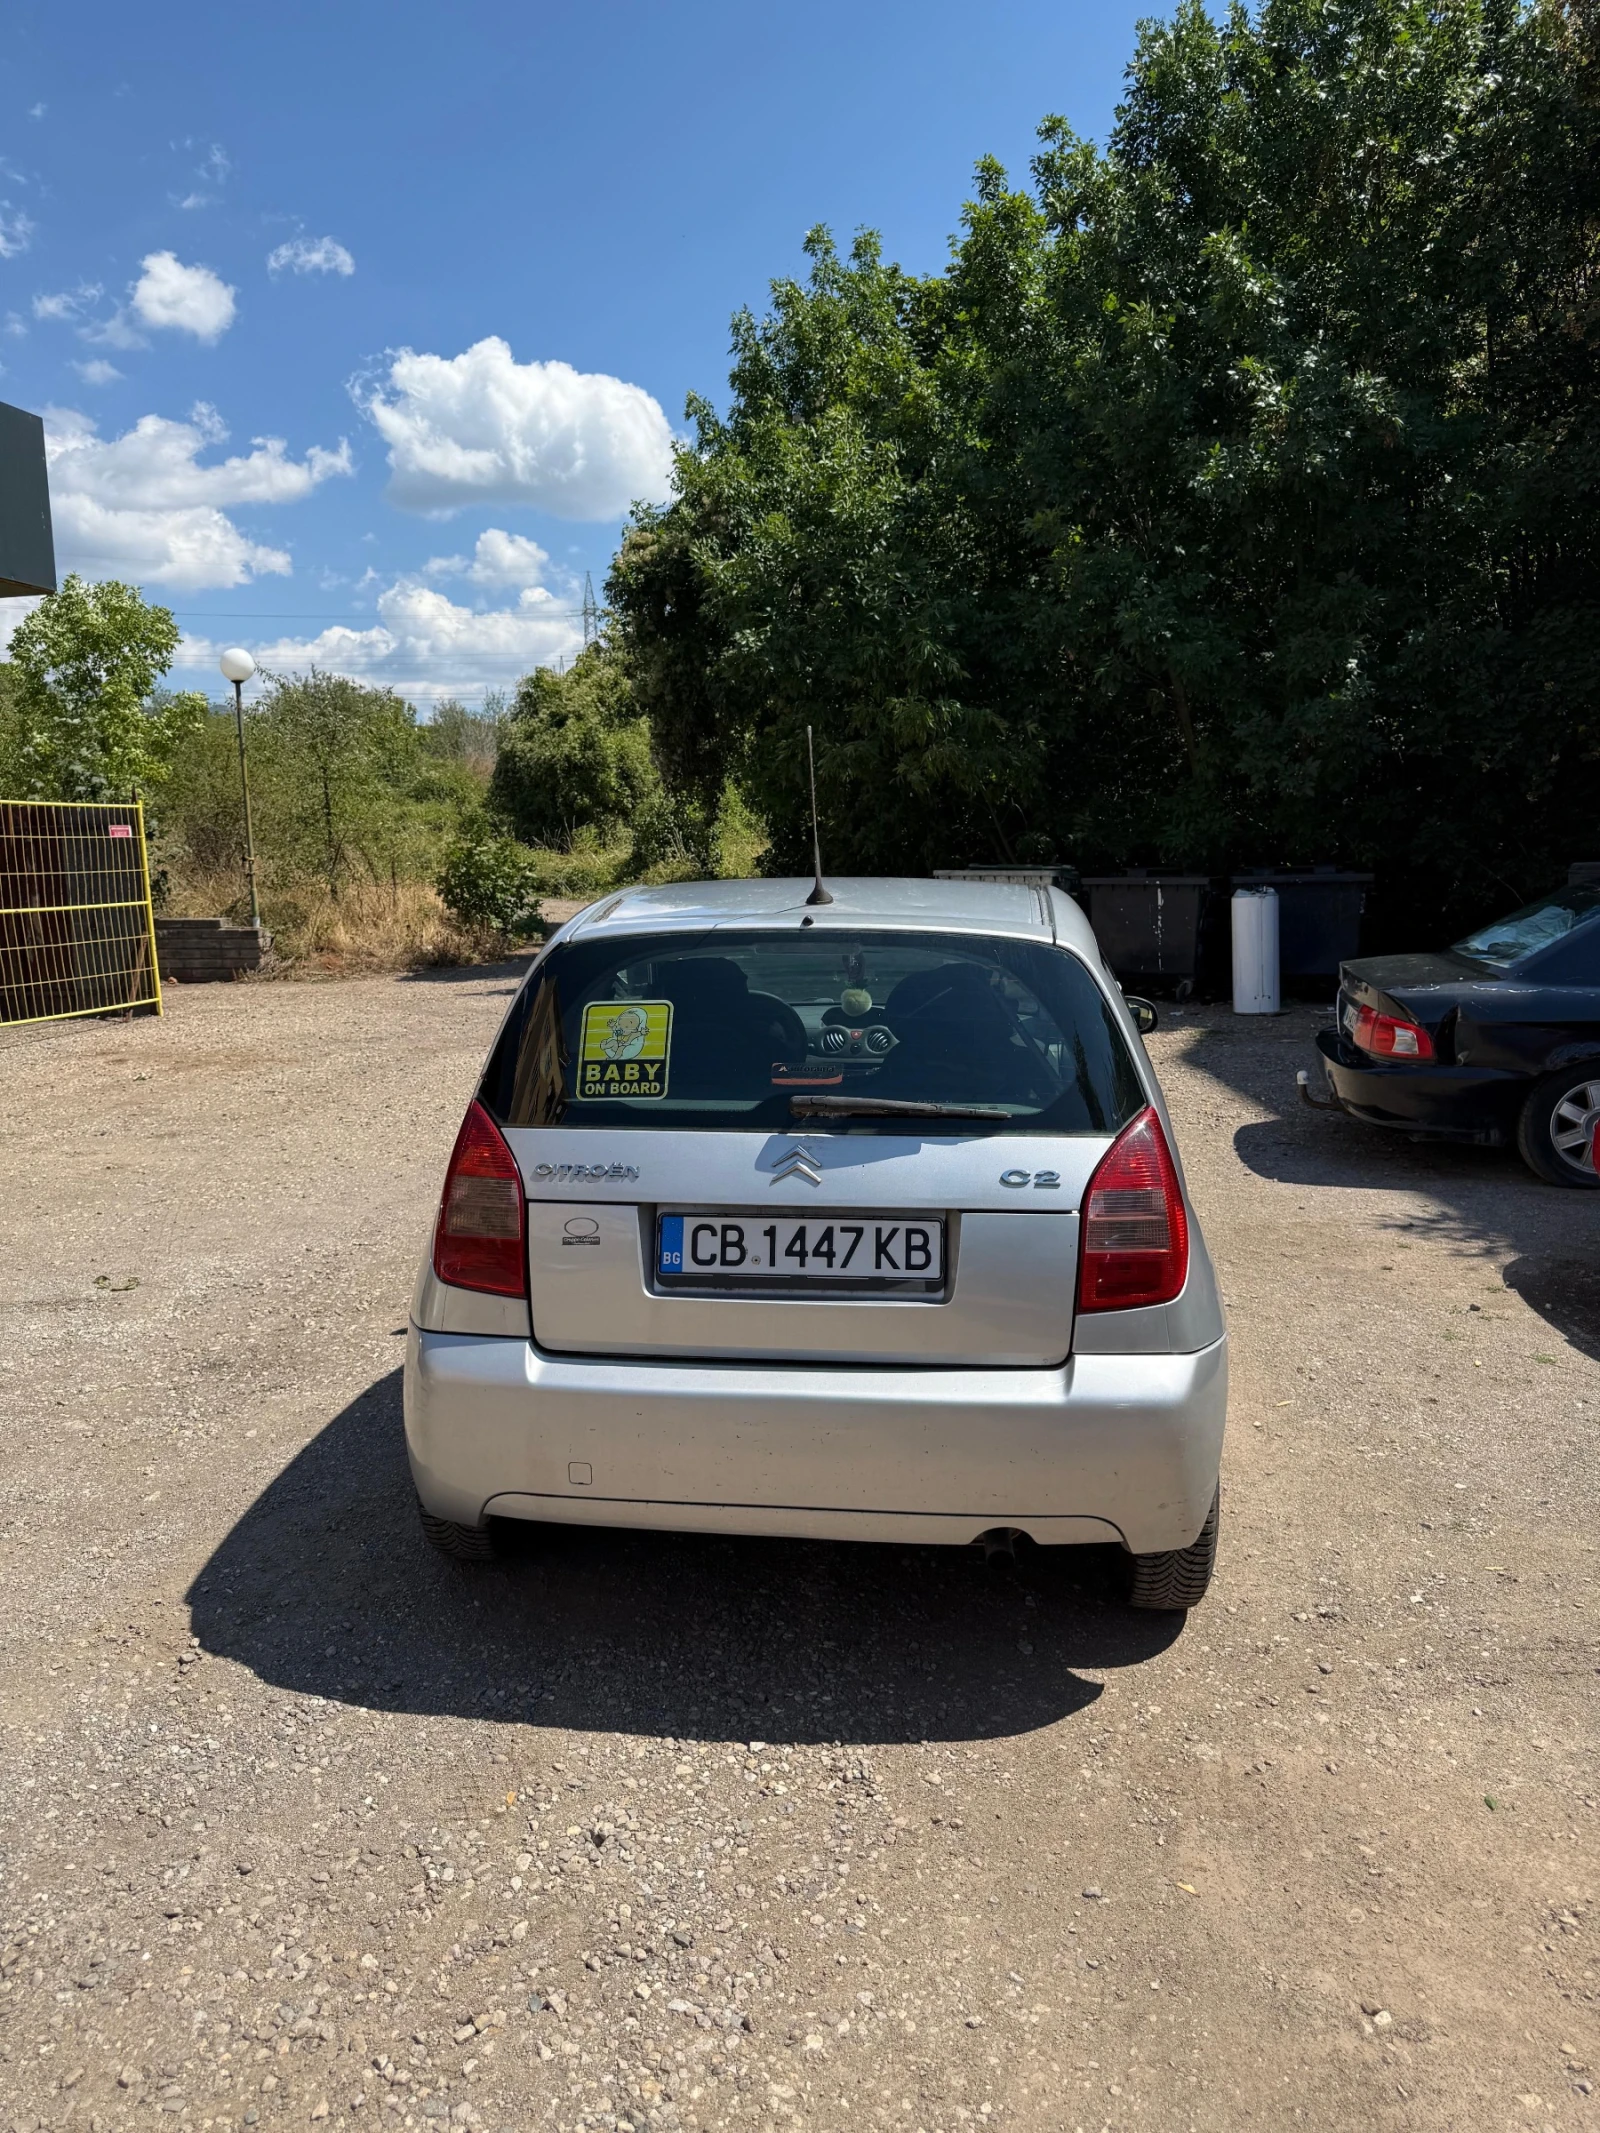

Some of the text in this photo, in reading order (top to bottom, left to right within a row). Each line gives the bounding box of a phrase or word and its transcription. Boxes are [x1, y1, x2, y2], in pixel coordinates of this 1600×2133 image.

[586, 1064, 661, 1081] BABY
[585, 1082, 660, 1095] ON BOARD
[535, 1162, 639, 1178] CITROËN
[1000, 1169, 1061, 1188] C2
[692, 1223, 932, 1270] CB 1447 KB
[663, 1252, 680, 1264] BG
